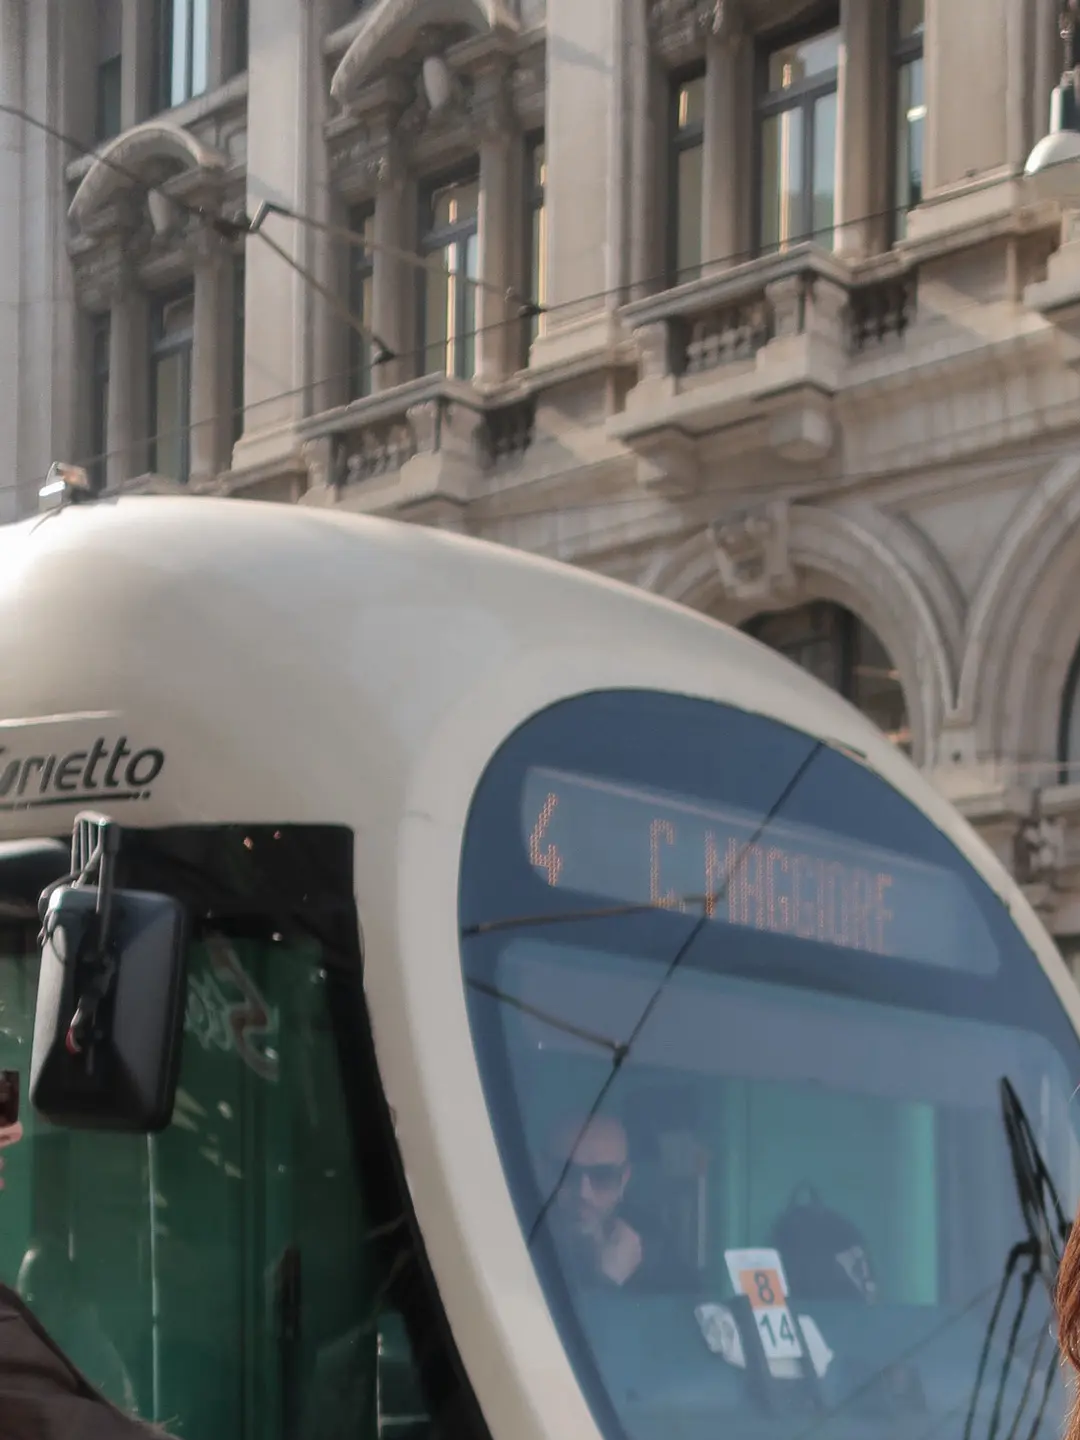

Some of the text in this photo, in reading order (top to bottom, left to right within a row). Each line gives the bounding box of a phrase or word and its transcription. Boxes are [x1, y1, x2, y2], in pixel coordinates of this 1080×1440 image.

[529, 792, 561, 887] 4
[754, 1271, 775, 1305] 8
[759, 1312, 796, 1349] 14
